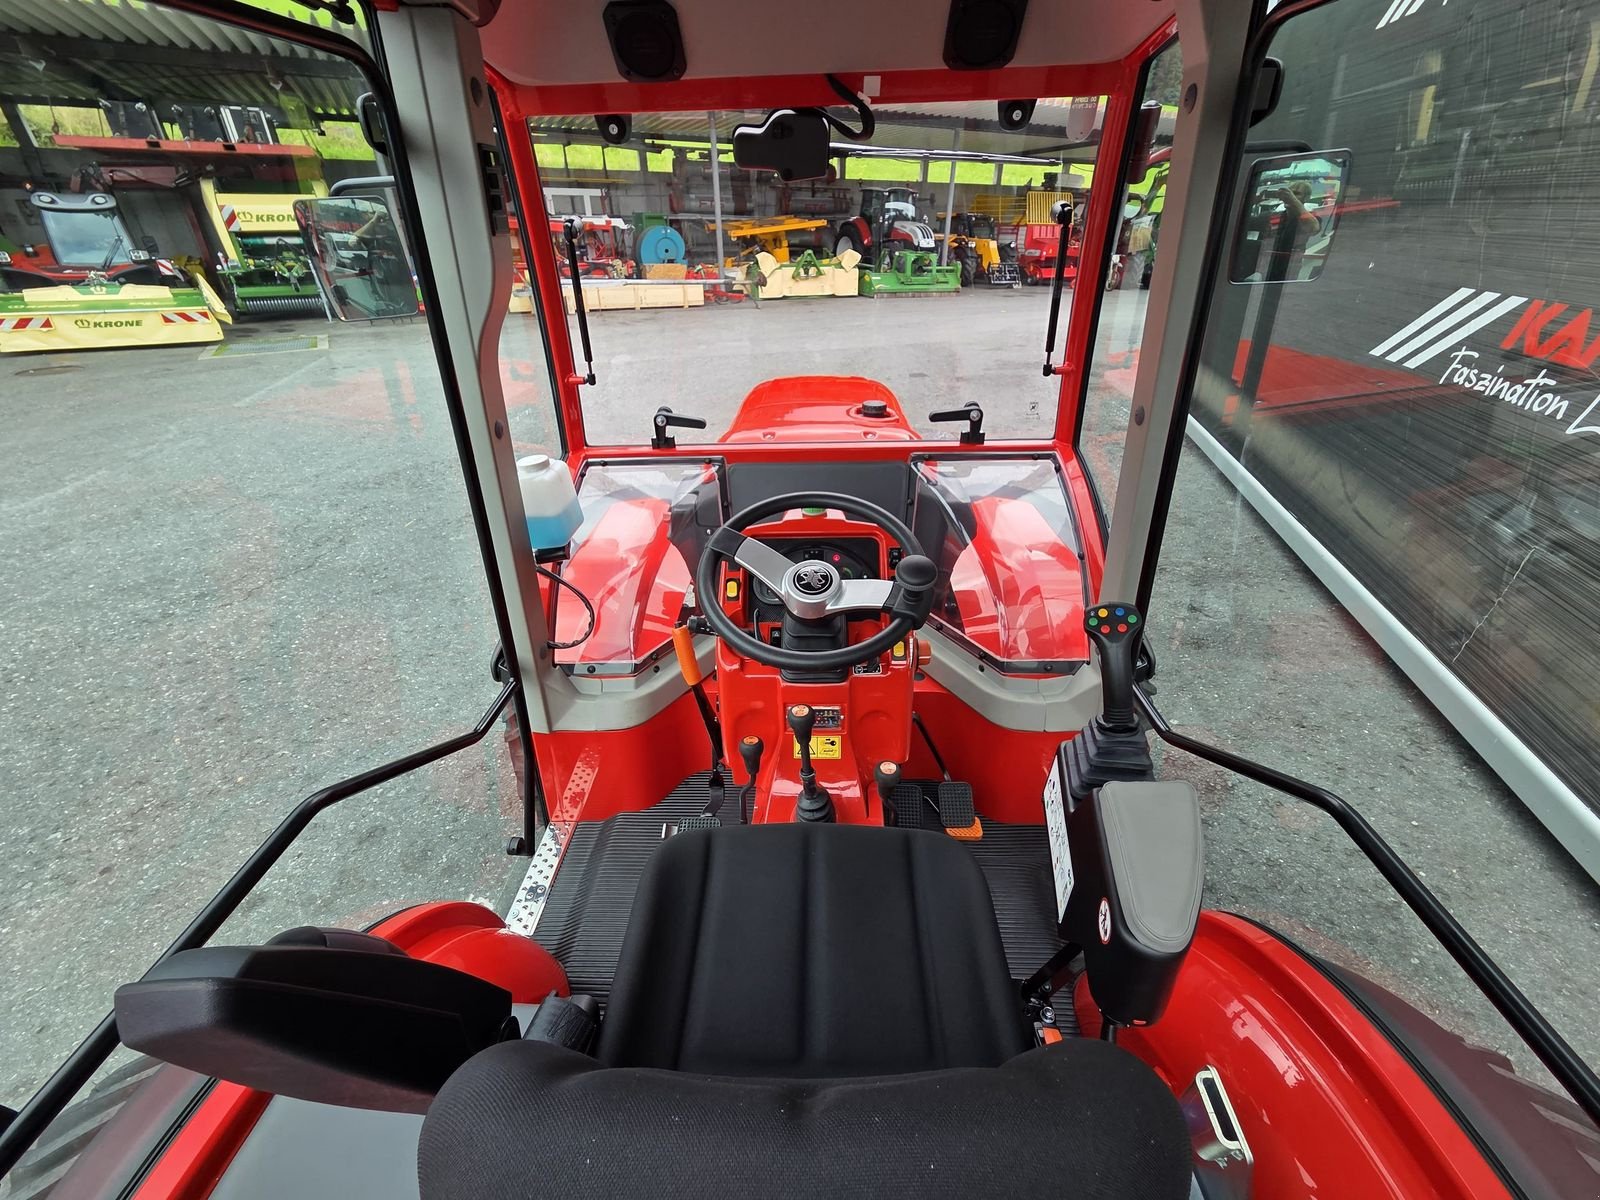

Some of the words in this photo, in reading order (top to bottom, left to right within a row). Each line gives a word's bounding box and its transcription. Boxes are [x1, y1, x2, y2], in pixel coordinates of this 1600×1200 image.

[255, 213, 297, 223] KRON
[93, 319, 144, 328] KRONE
[1501, 298, 1600, 369] KA
[1439, 346, 1569, 420] Faszination
